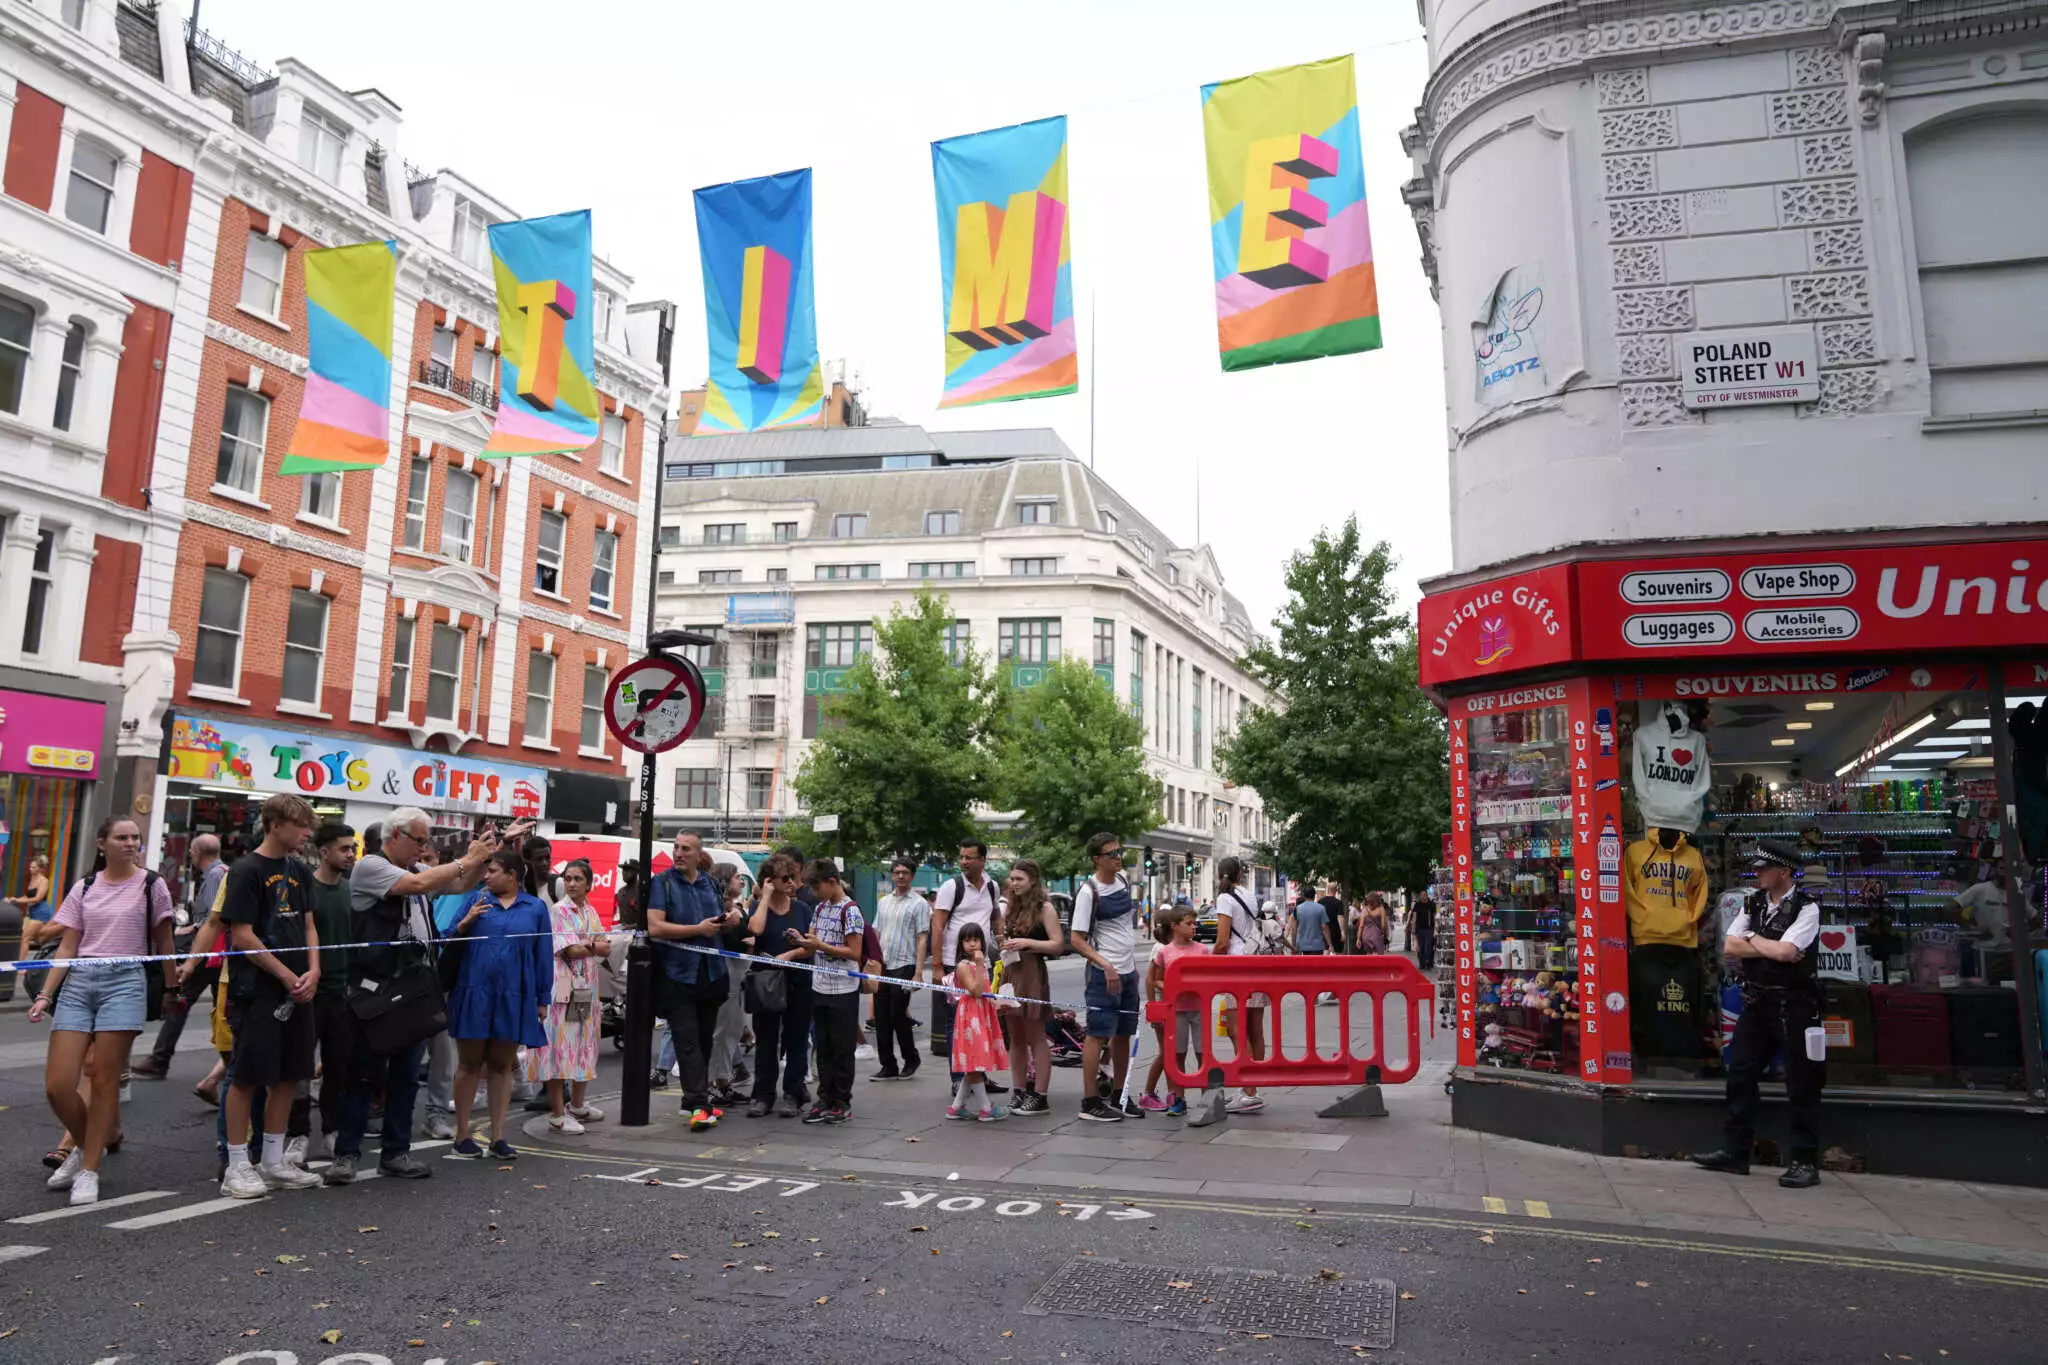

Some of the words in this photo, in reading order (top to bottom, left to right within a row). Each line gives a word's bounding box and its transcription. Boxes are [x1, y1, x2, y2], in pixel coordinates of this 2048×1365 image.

[1237, 131, 1340, 290] E
[947, 189, 1067, 352] M
[516, 279, 576, 412] T
[1693, 341, 1772, 363] POLAND
[1695, 363, 1768, 385] STREET
[1775, 360, 1805, 379] W1
[1697, 395, 1717, 404] CITY
[1719, 393, 1732, 402] OF
[1734, 388, 1799, 401] WESTMINSTER
[1638, 578, 1713, 597] Souvenirs
[1755, 571, 1796, 594] Vape
[1799, 569, 1840, 592] Shop
[1431, 589, 1504, 657] Unique
[1512, 586, 1561, 636] Gifts
[1640, 619, 1716, 640] Luggages
[1760, 623, 1844, 638] Accessories
[1775, 613, 1826, 626] Mobile
[1674, 671, 1838, 696] SOUVENIRS
[1467, 695, 1497, 712] OFF
[1499, 684, 1567, 708] LICENCE
[1656, 745, 1666, 763] I
[270, 743, 371, 793] TOYS
[382, 767, 401, 796] &
[1453, 718, 1466, 832] VARIETY
[1648, 762, 1699, 785] LONDON
[1574, 720, 1591, 845] QUALITY
[592, 869, 613, 892] pd
[1457, 854, 1468, 883] OF
[1580, 868, 1598, 1034] GUARANTEE
[1817, 952, 1853, 972] NDON
[1459, 905, 1472, 1039] PRODUCTS
[1656, 1001, 1690, 1013] KING
[596, 1167, 823, 1197] LEFT
[883, 1190, 1103, 1221] LOOK
